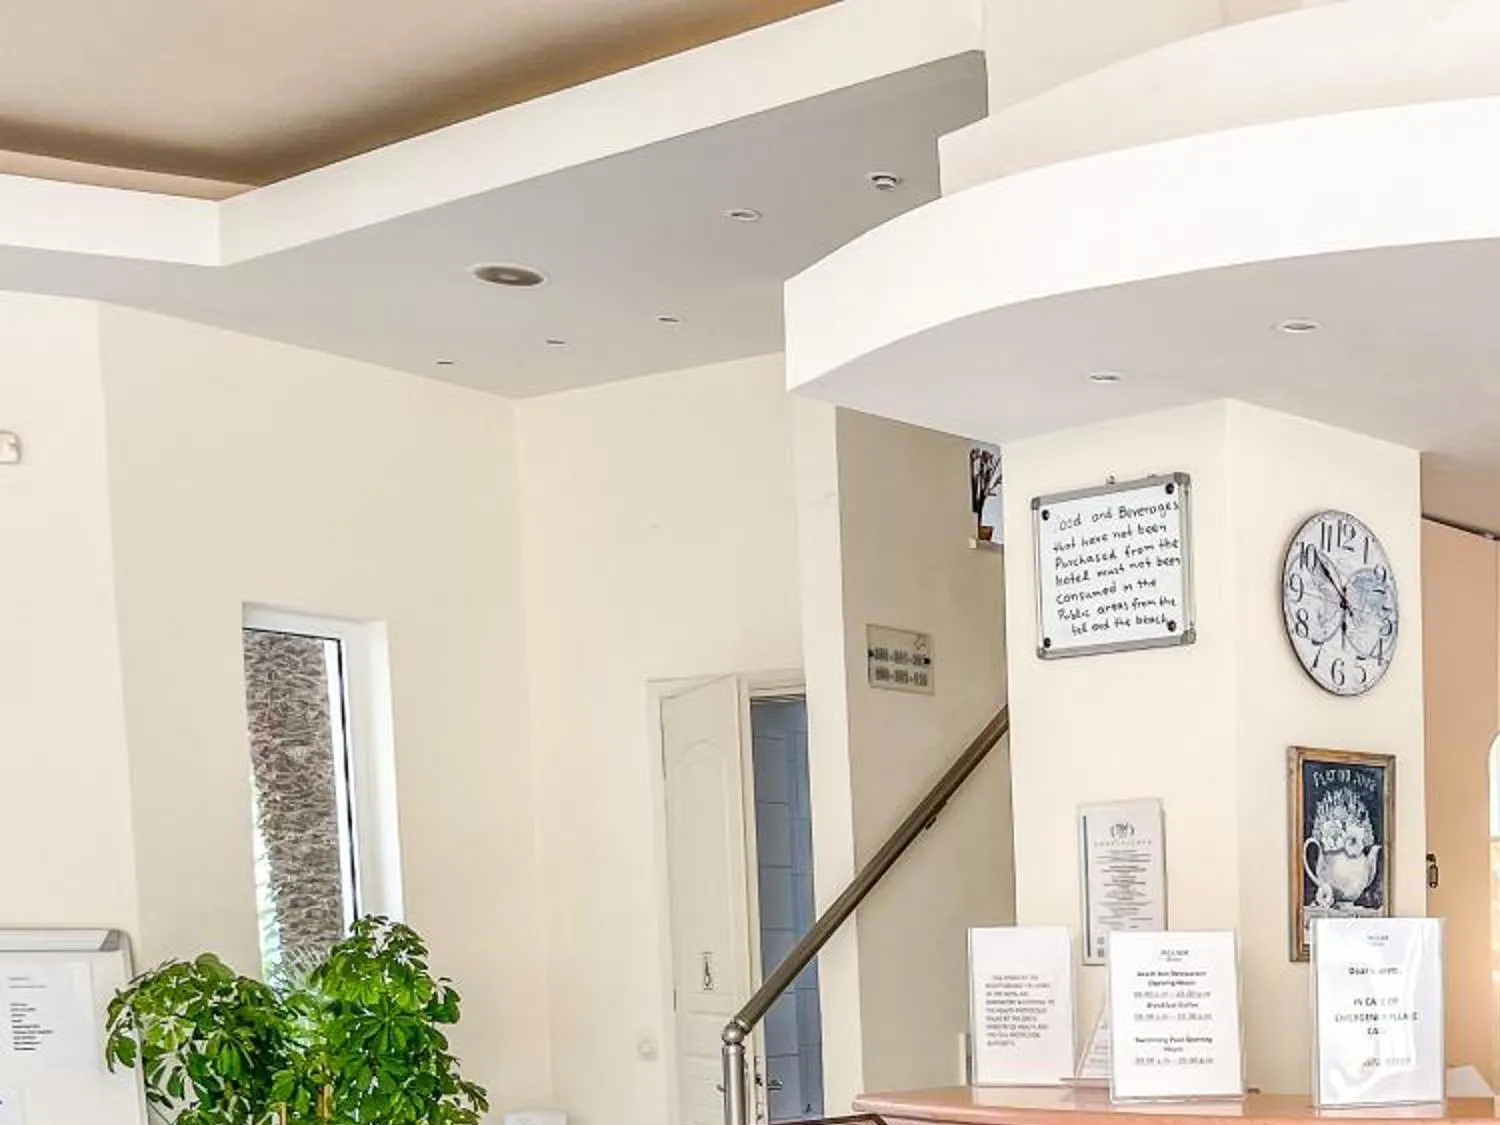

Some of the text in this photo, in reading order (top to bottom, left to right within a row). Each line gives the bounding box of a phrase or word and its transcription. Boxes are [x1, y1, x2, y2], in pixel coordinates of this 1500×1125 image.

[1059, 501, 1180, 531] ood and Beverages
[1082, 533, 1109, 547] have
[1112, 527, 1134, 540] not
[1137, 521, 1168, 536] been
[1124, 543, 1156, 559] from
[1159, 537, 1180, 550] the
[1320, 521, 1333, 553] 11
[1337, 518, 1357, 552] 12
[1299, 541, 1319, 573] 10
[1362, 536, 1370, 565] 1
[1056, 553, 1181, 587] hotel must not been
[1137, 577, 1158, 590] the
[1373, 563, 1388, 595] 2
[1288, 571, 1305, 602] 9
[1097, 599, 1130, 616] areas
[1131, 597, 1157, 612] from
[1159, 595, 1178, 608] the
[1114, 616, 1131, 629] the
[1294, 607, 1310, 639] 8
[1379, 606, 1394, 637] 3
[1311, 639, 1325, 669] 7
[1368, 637, 1385, 667] 4
[1331, 657, 1346, 687] 6
[1355, 653, 1368, 685] 5
